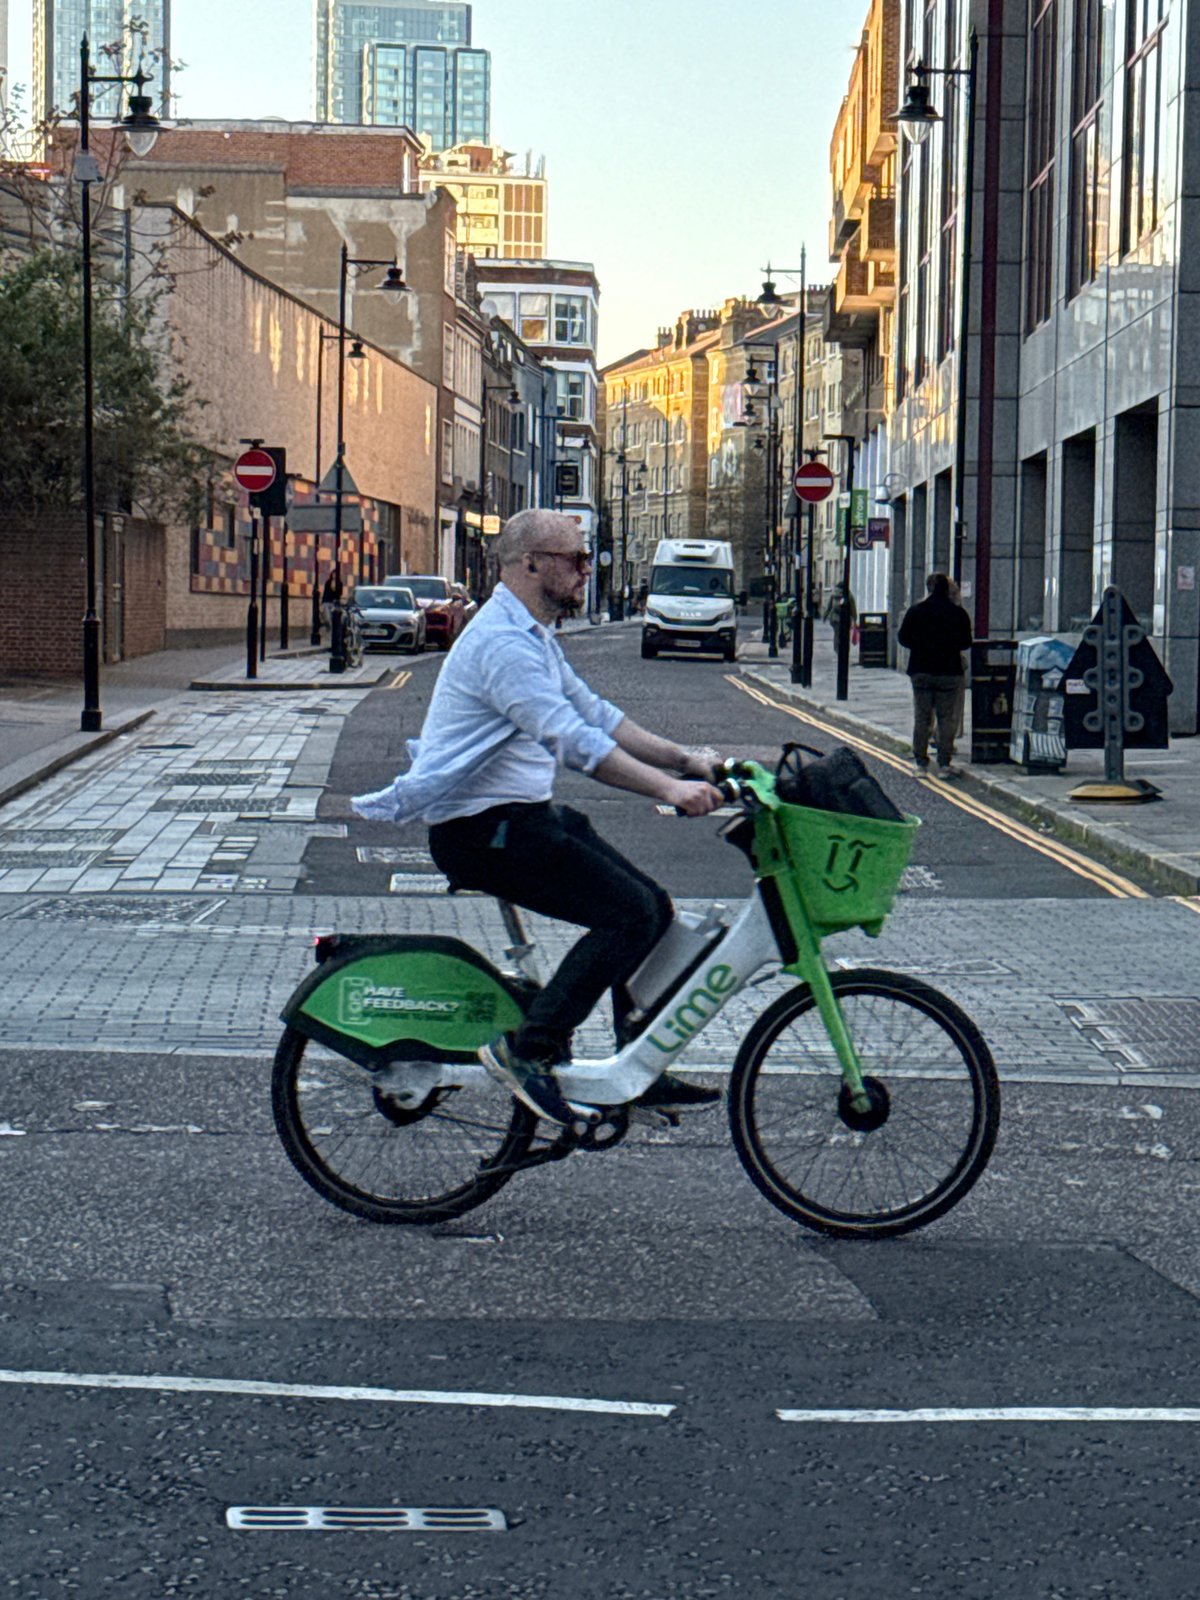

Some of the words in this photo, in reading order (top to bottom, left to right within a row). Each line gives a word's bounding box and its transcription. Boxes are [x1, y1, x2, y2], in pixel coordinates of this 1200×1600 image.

[363, 986, 405, 998] HAVE
[363, 998, 460, 1012] FEEDBACK?
[646, 964, 738, 1053] Lime
